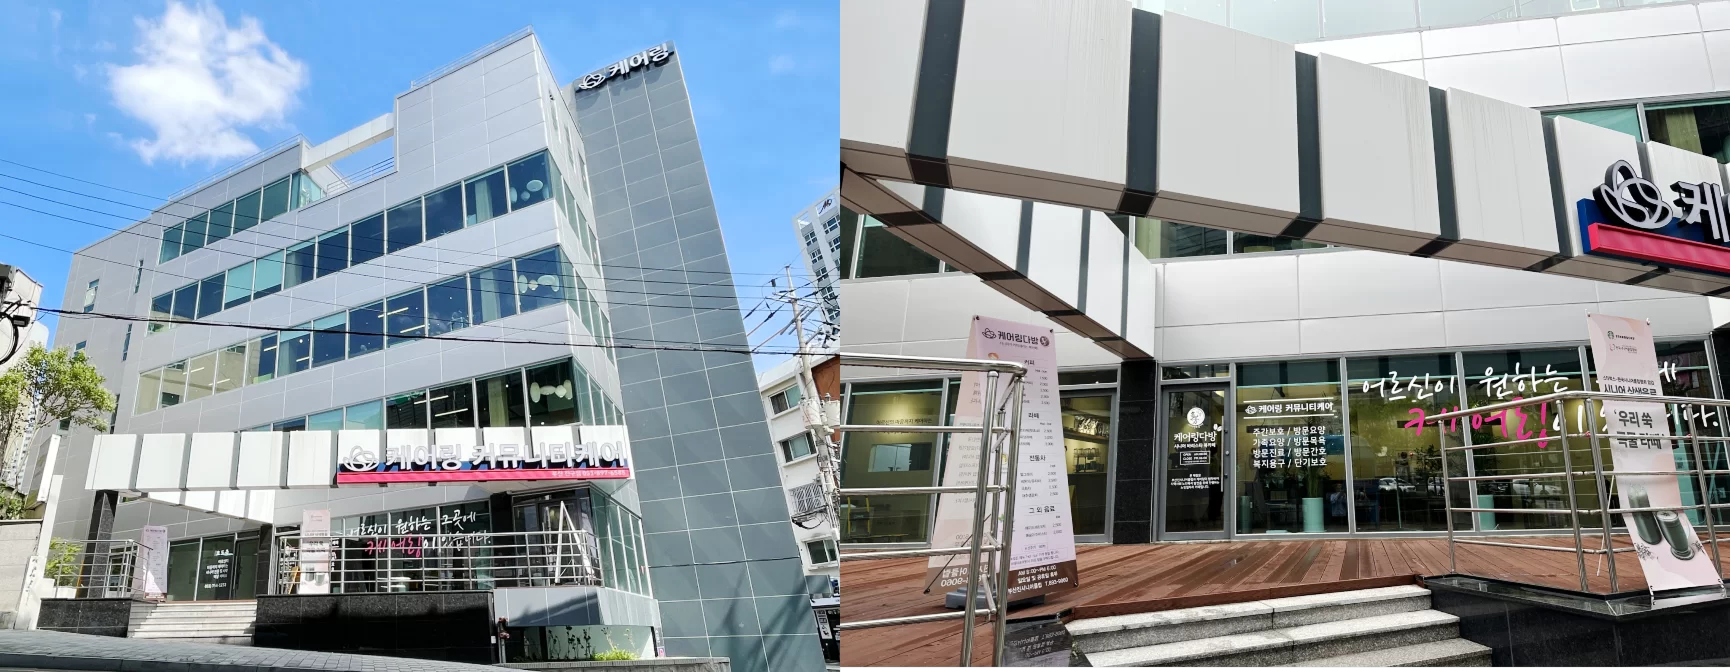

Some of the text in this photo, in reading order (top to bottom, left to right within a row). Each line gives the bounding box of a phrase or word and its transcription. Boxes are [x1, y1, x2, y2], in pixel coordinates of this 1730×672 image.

[608, 43, 668, 76] 케어링
[1670, 181, 1730, 243] 케
[1362, 362, 1569, 402] 어르신이 원하는
[1604, 384, 1626, 394] 시니어
[1258, 402, 1334, 414] 케어링 커뮤니티케어
[1641, 411, 1653, 428] 쑥
[1174, 431, 1218, 443] 케어링다방
[1252, 427, 1285, 437] 주간보호
[1293, 426, 1326, 436] 방문요양
[1252, 438, 1285, 447] 가족요양
[1293, 436, 1326, 446] 방문목욕
[386, 441, 625, 470] 케어링 커뮤니티케어
[1252, 448, 1285, 458] 방문진료
[1294, 447, 1327, 457] 방문간호
[1252, 459, 1286, 469] 복지용구
[1294, 457, 1328, 467] 단기보호
[395, 515, 432, 534] 원하는
[441, 509, 477, 530] 그곳에
